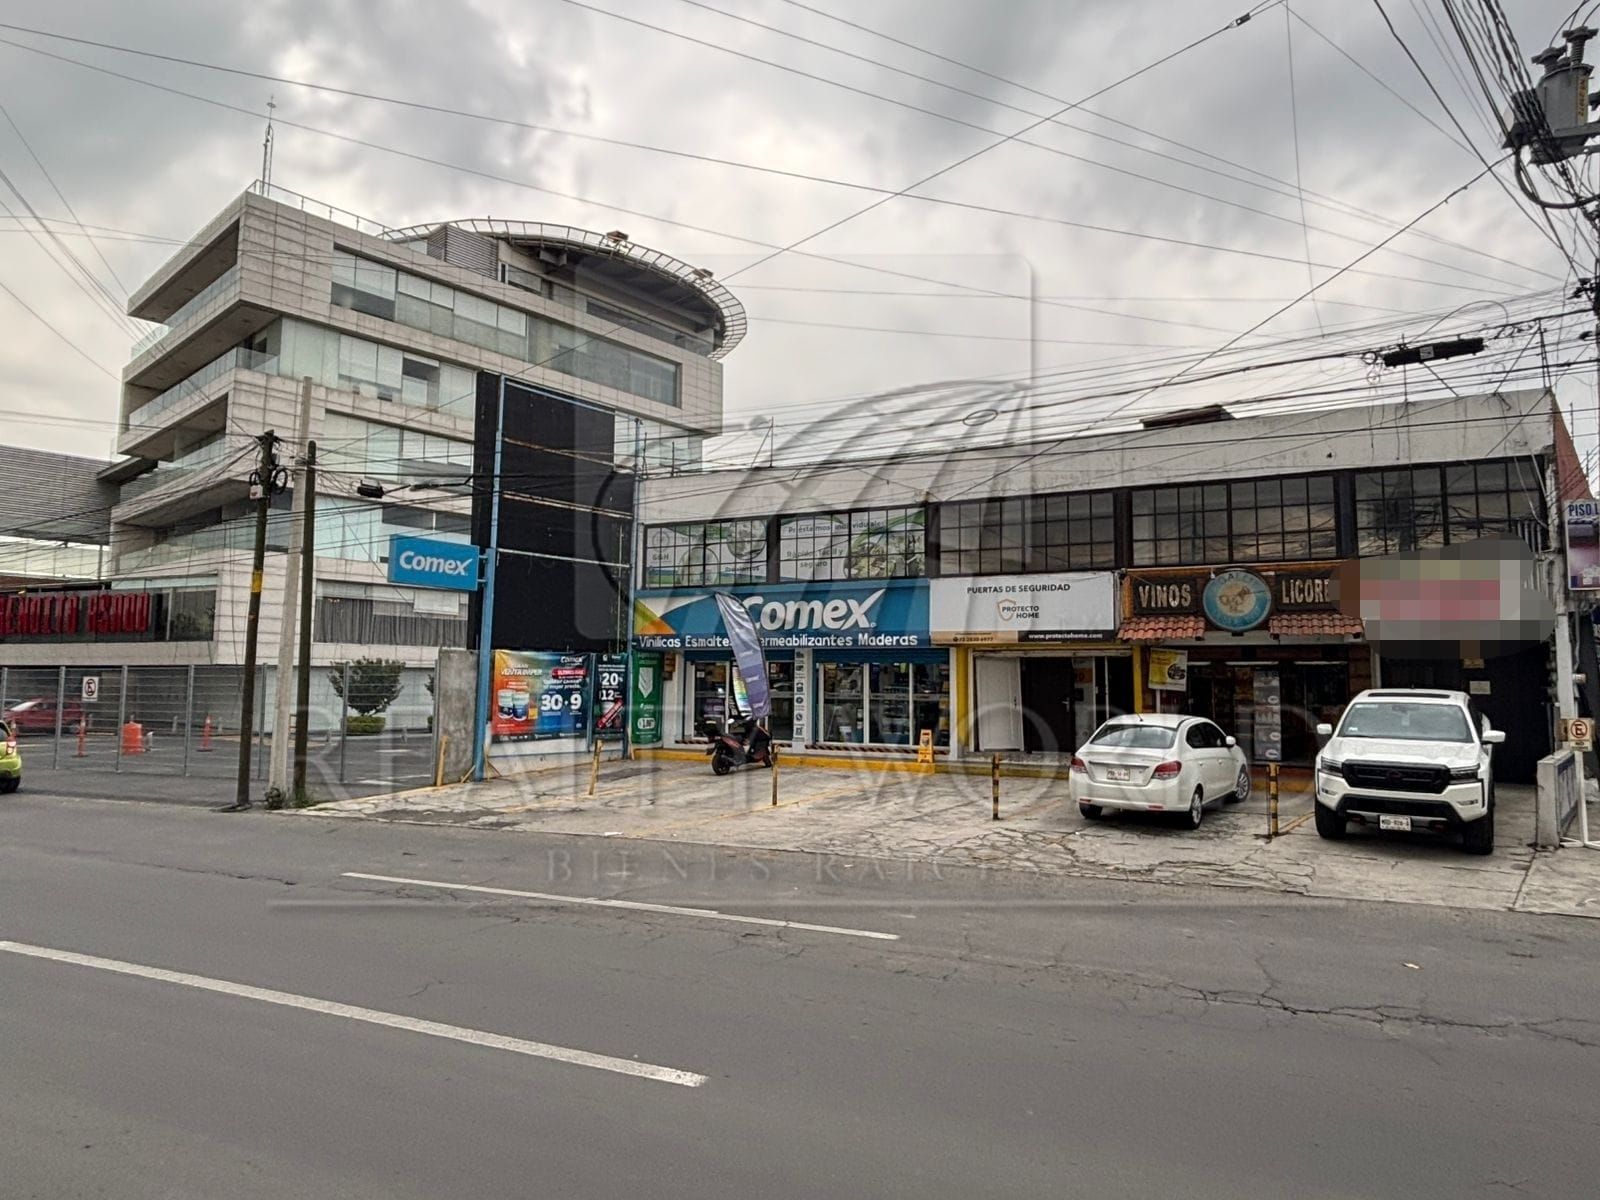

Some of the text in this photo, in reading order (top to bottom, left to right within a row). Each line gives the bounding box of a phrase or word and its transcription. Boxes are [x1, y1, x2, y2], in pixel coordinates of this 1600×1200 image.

[1568, 503, 1592, 517] PISO
[399, 550, 473, 576] Comex
[966, 583, 1071, 594] PUERTAS DE SEGURIDAD
[1138, 584, 1192, 608] VINOS
[740, 588, 887, 631] Comex
[1001, 605, 1040, 613] PROTECTO
[858, 632, 918, 646] Maderas
[600, 689, 615, 700] 12
[540, 693, 583, 711] 30 9
